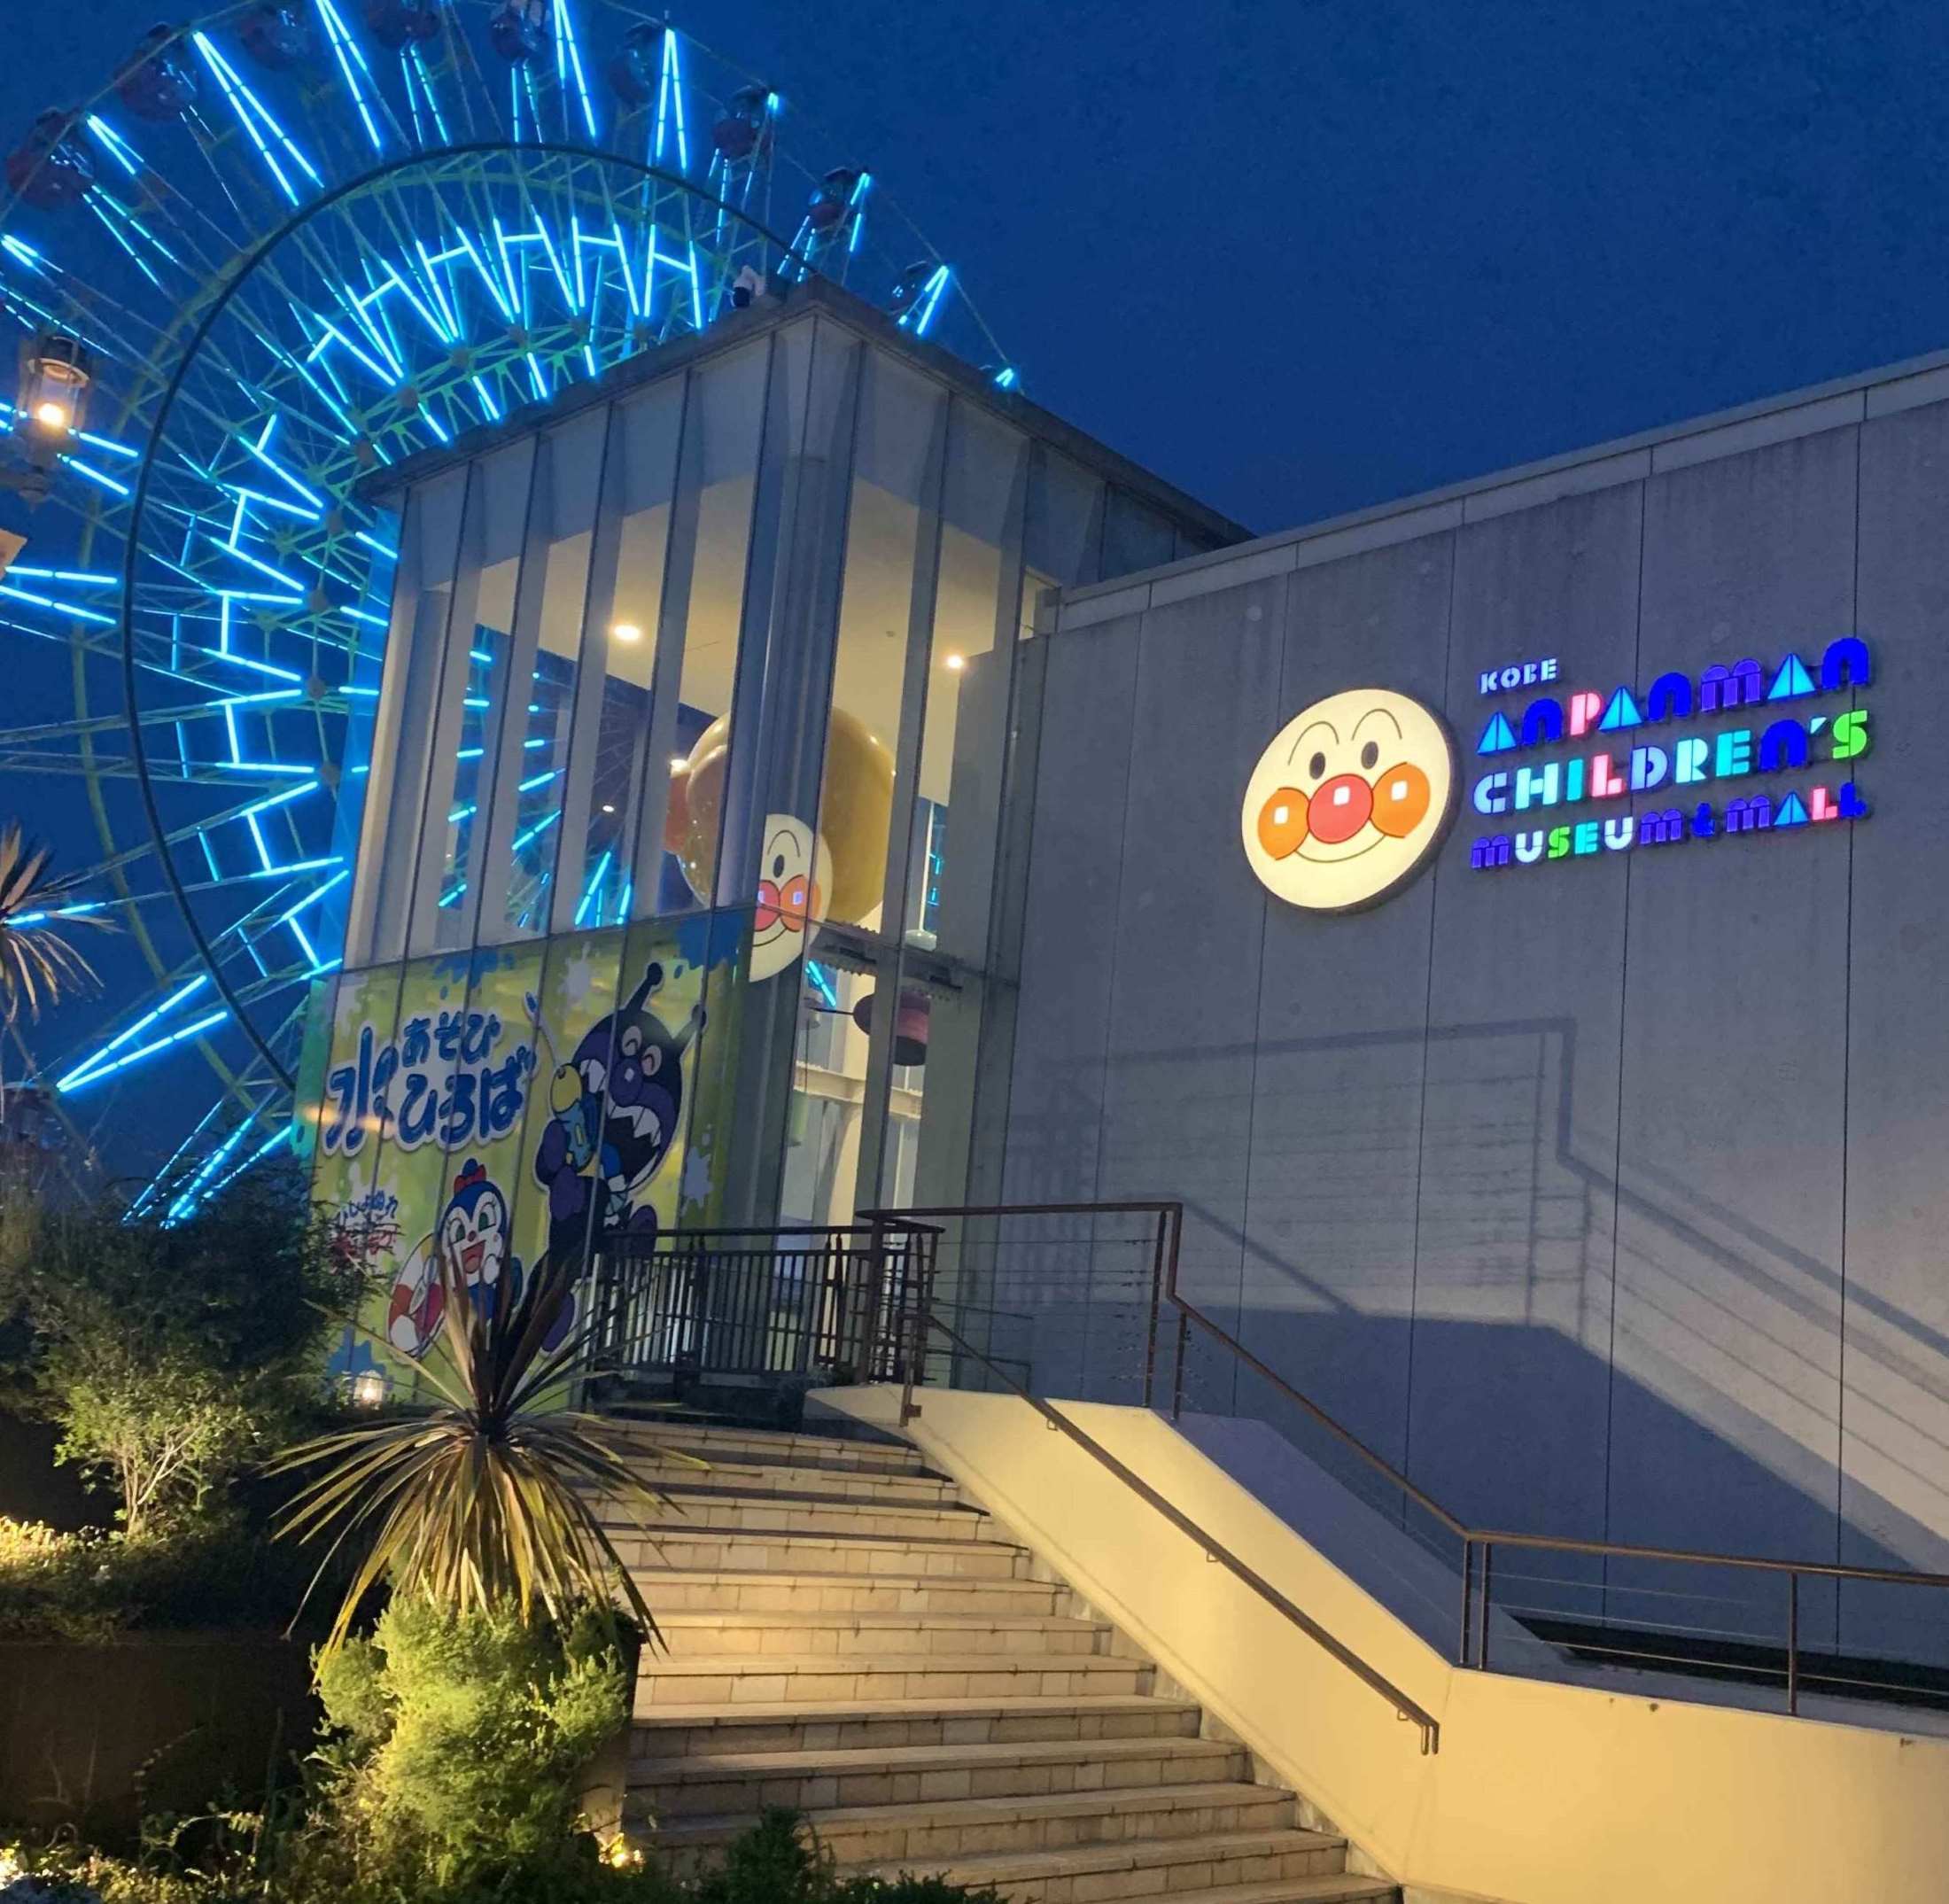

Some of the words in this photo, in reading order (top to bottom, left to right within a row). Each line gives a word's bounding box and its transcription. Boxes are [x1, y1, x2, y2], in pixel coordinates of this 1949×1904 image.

[1477, 637, 1869, 756] ANPANMAN
[1480, 658, 1557, 694] KOBE
[1473, 710, 1868, 814] CHILDREN'S
[1471, 808, 1683, 869] MUSEUM
[1726, 781, 1867, 834] MALL
[399, 1045, 537, 1145] ひろば
